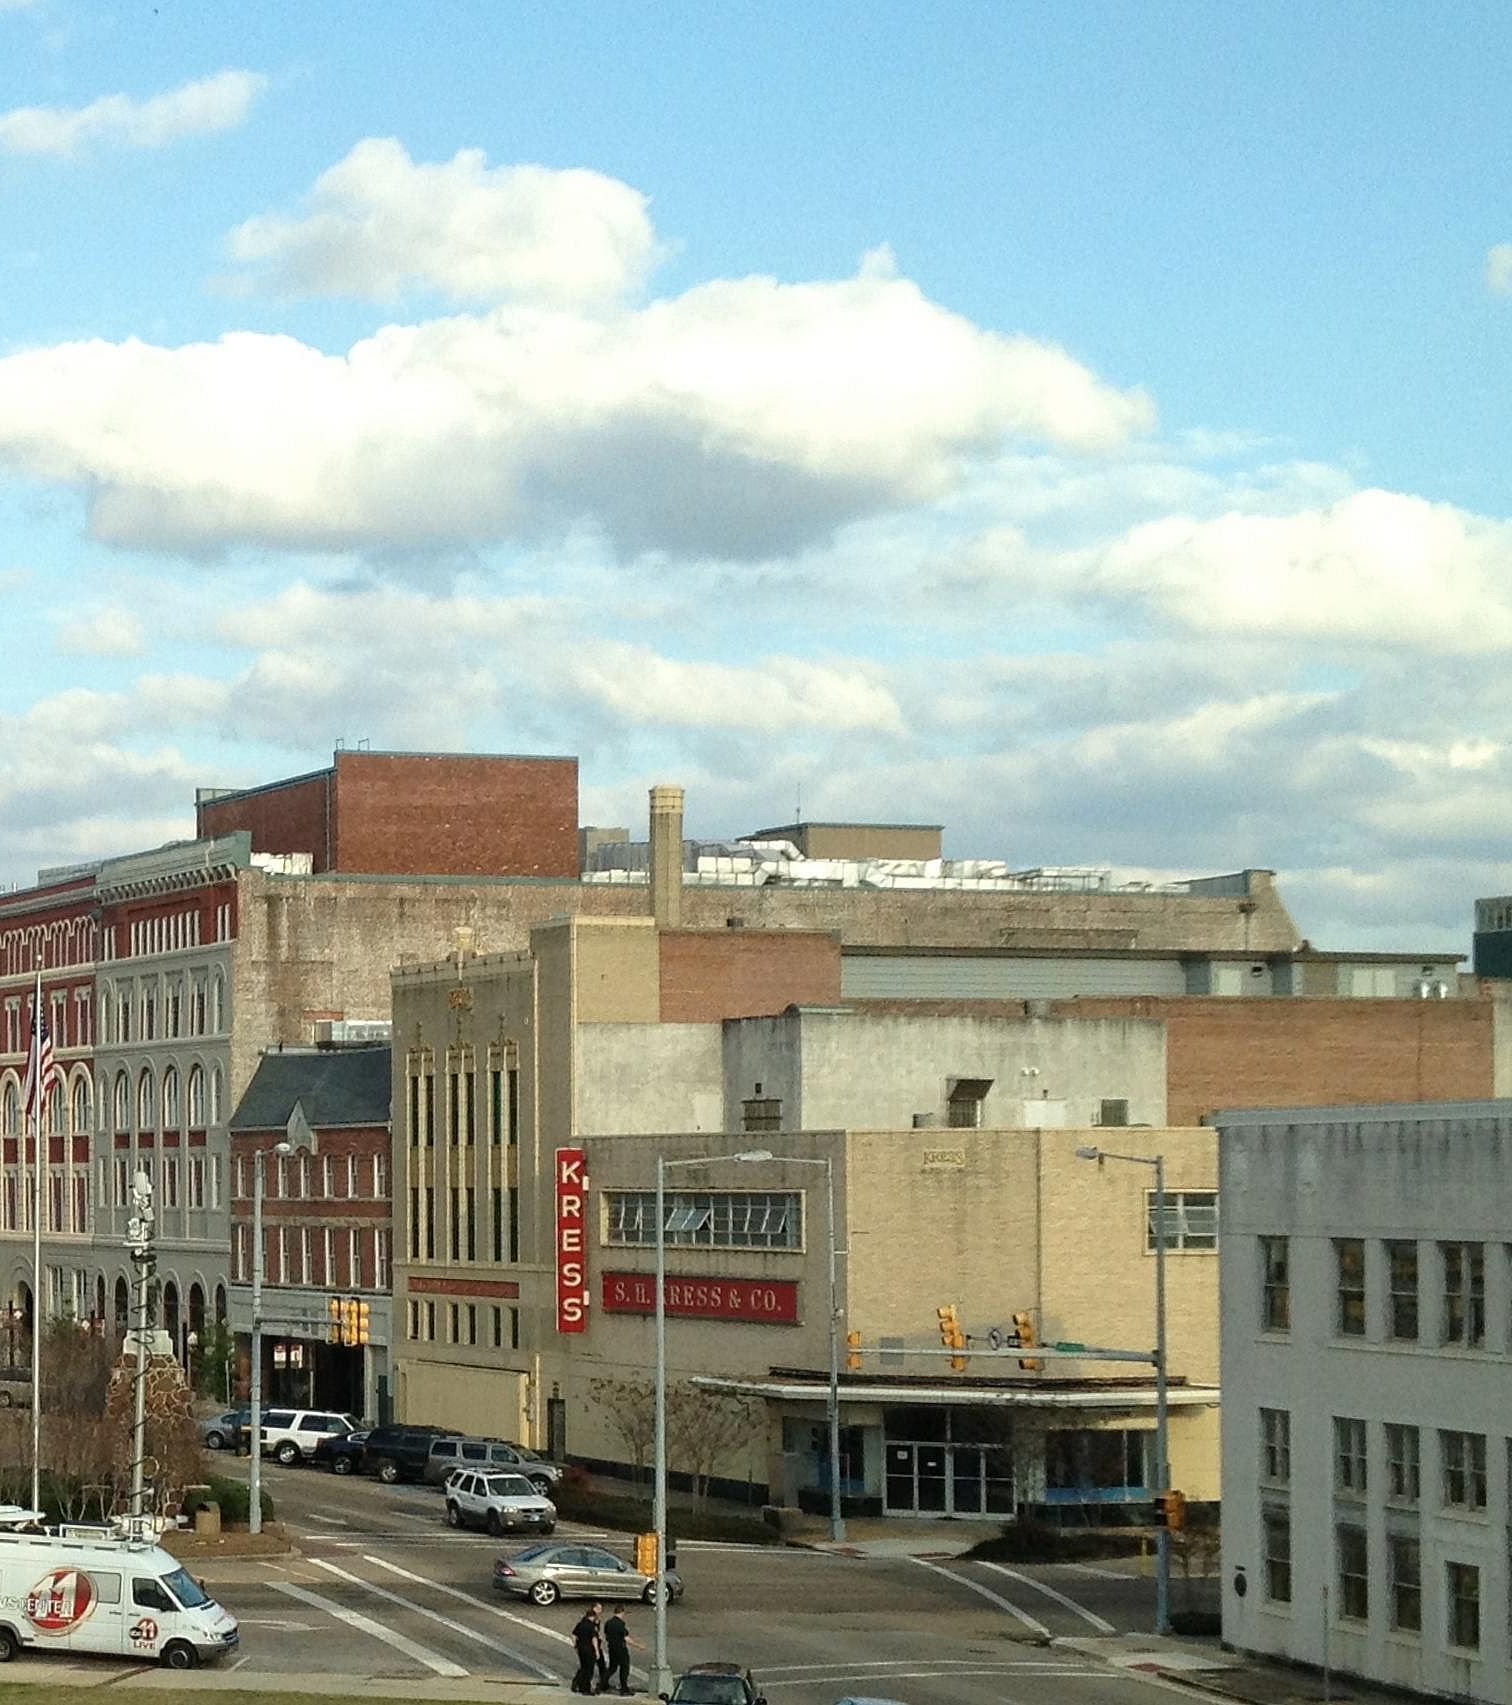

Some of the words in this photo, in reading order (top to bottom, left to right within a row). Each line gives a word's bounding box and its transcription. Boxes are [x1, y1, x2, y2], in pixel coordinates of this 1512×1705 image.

[561, 1161, 582, 1321] KRESS
[615, 1282, 630, 1302] S.
[662, 1285, 721, 1308] RESS
[729, 1288, 741, 1308] &
[751, 1289, 782, 1311] CO.
[134, 1641, 155, 1650] LIVE
